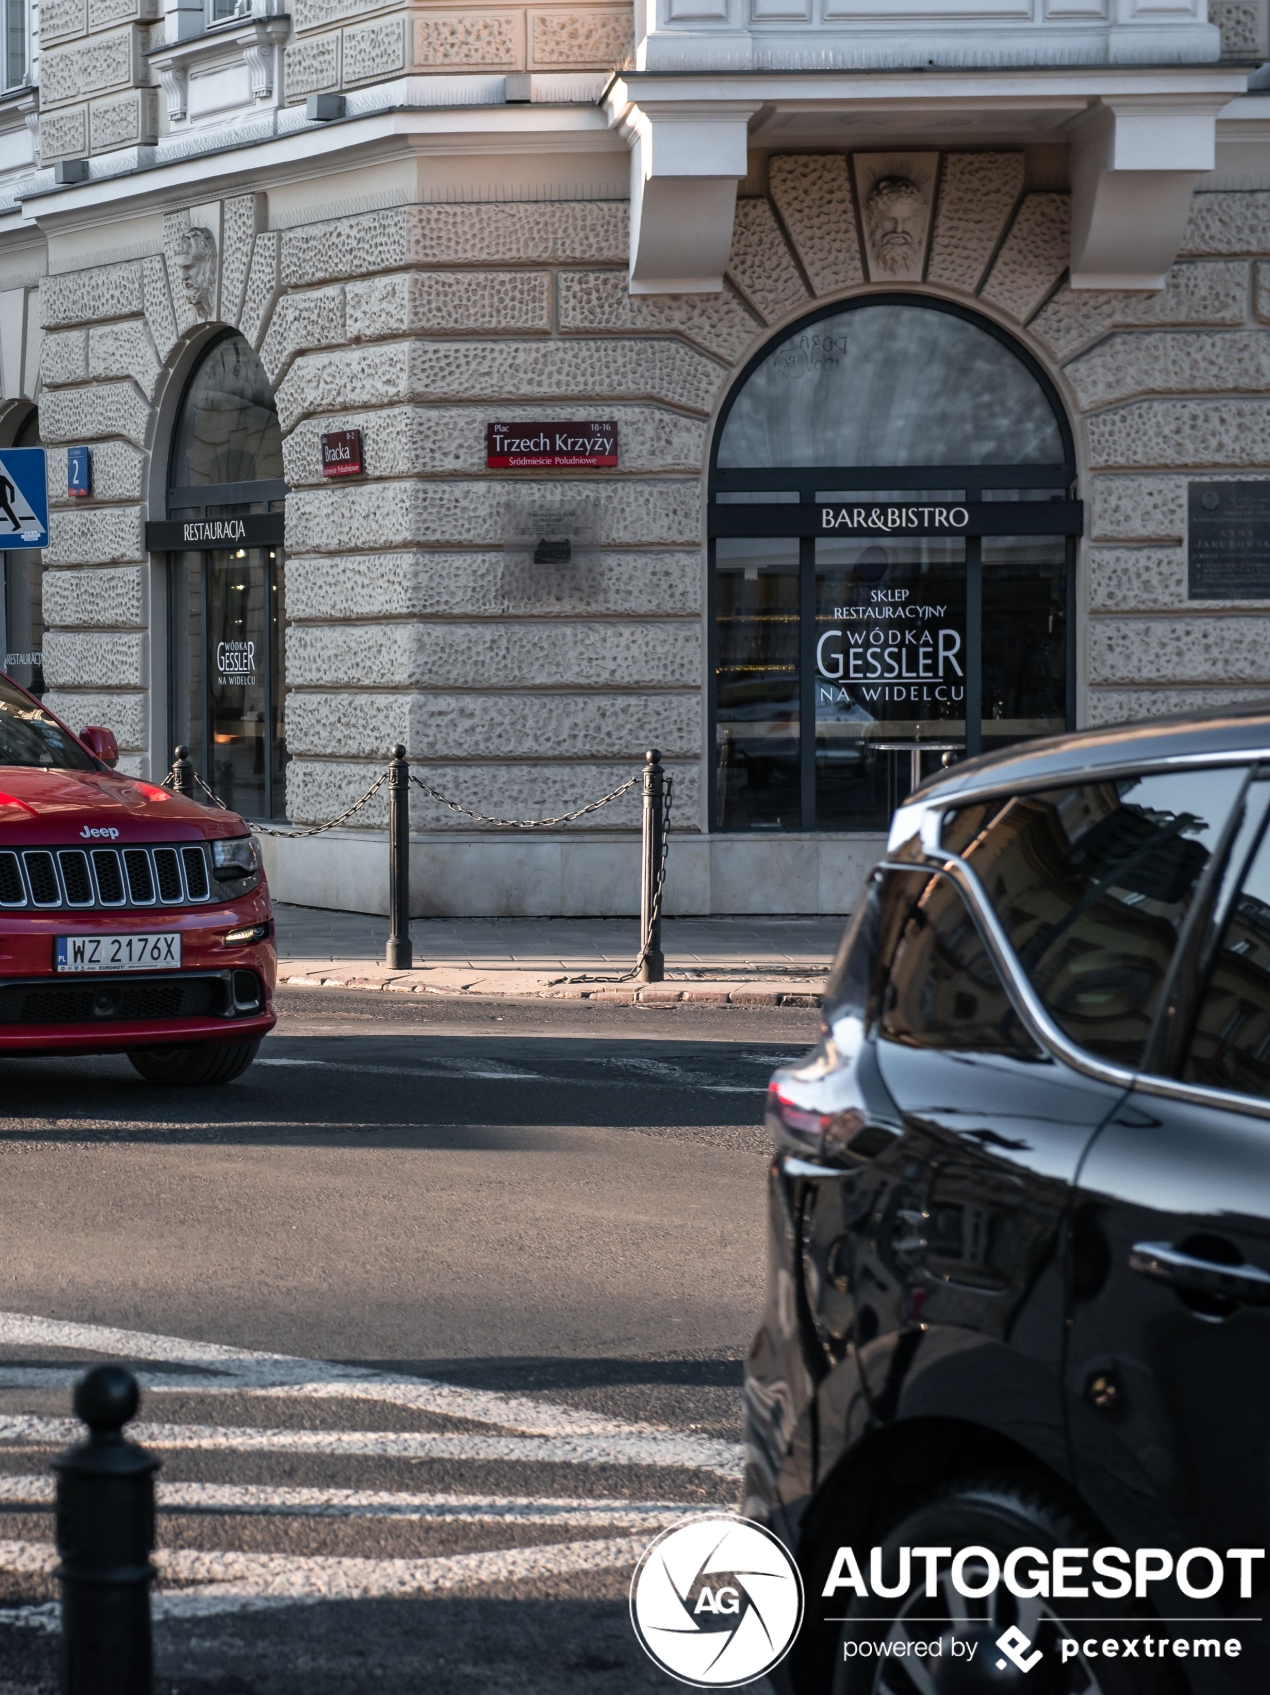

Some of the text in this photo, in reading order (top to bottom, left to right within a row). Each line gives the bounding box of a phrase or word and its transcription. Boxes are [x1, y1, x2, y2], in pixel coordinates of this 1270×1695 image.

[494, 424, 510, 433] Plac
[590, 423, 611, 431] 18-16
[324, 441, 350, 462] Bracka
[492, 432, 614, 456] Trzech Krzyży
[509, 456, 597, 466] Śródmieście Południowe
[72, 459, 80, 485] 2
[821, 507, 969, 532] BAR&BISTRO
[183, 519, 246, 542] RESTAURACJA
[870, 588, 910, 602] SKLEP
[834, 605, 947, 621] RESTAURACYJNY
[846, 627, 933, 645] WÓDKA
[224, 640, 248, 651] WÓDKA
[217, 641, 256, 672] GESSLER
[816, 629, 963, 679] GESSLER
[218, 675, 256, 685] NA WIDELCU
[820, 686, 964, 702] NA WIDELCU
[80, 825, 120, 840] Jeep
[72, 936, 176, 964] WZ 2176X
[58, 955, 67, 963] PL
